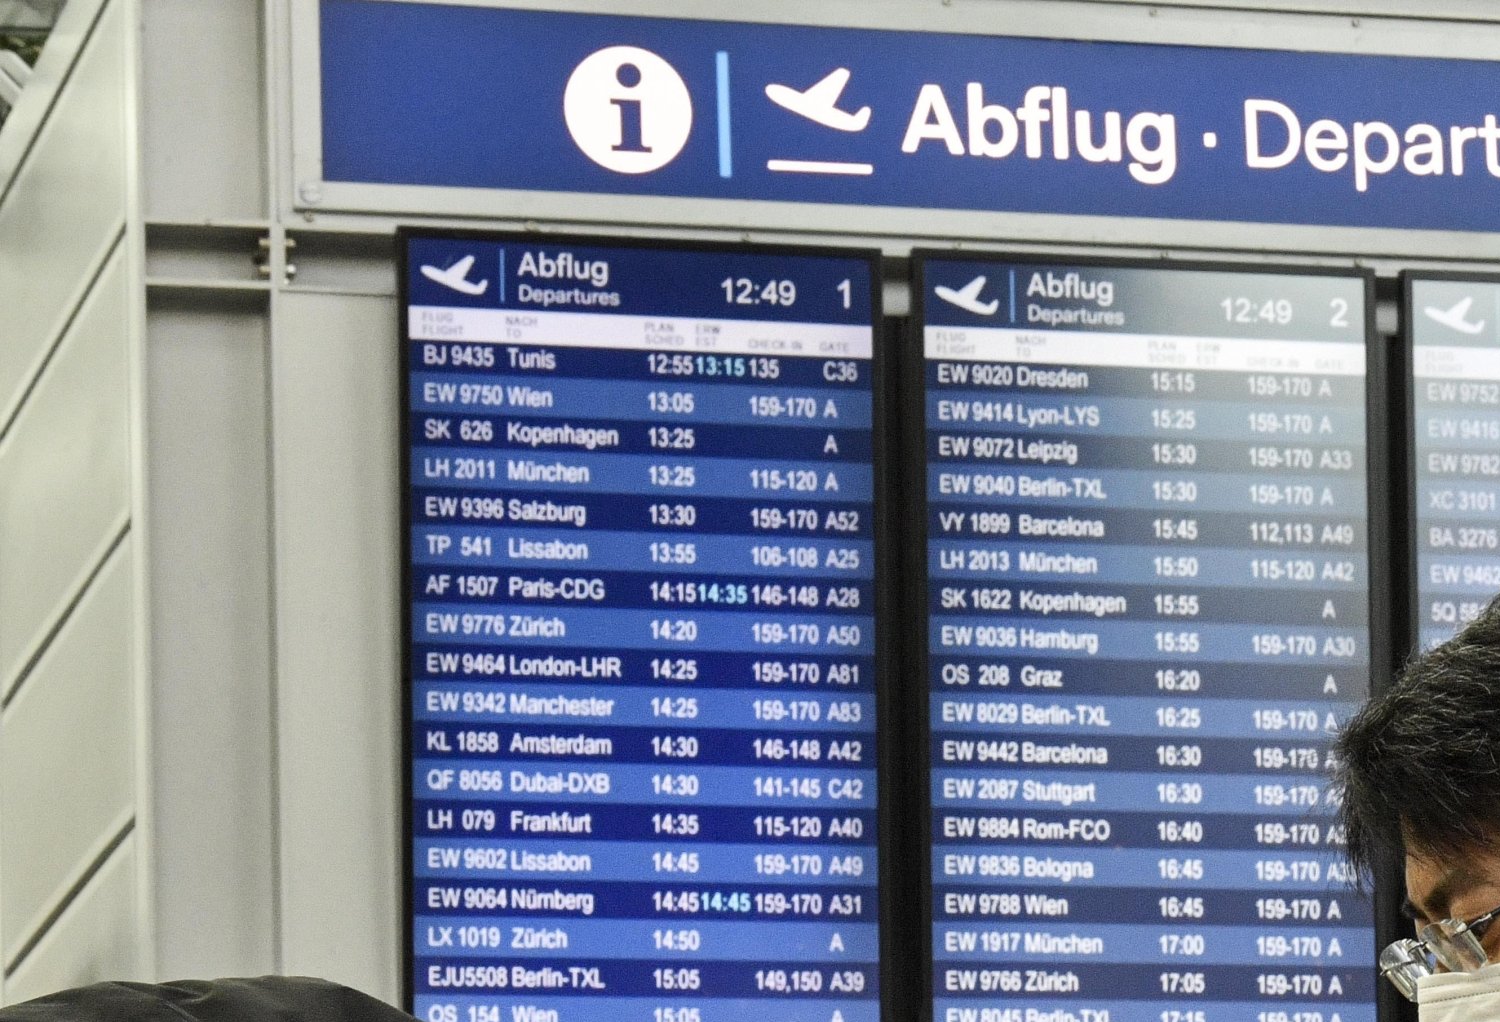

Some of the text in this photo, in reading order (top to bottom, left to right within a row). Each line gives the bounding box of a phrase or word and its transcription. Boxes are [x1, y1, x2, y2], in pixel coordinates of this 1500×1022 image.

[902, 83, 1177, 184] Abflug
[517, 252, 609, 287] Abflug
[519, 286, 620, 307] Departures
[720, 278, 851, 309] 12:49 1
[1028, 272, 1113, 306] Abflug
[1028, 305, 1125, 326] Departures
[1220, 297, 1348, 327] 12:49 2
[424, 346, 857, 381] BJ 9435 Tunis 12:55 13:15 135 C36
[938, 364, 1331, 396] EW 9020 Dresden 15:15 159-170 A
[1428, 383, 1458, 402] EW
[1461, 385, 1499, 402] 9752
[425, 420, 838, 453] SK 626 Kopenhagen 13:25 A
[425, 458, 838, 491] LH 2011 München 13:25 115-120 A
[1429, 455, 1459, 473] EW
[941, 513, 1353, 545] VY 1899 Barcelona 15:45 112,113 A49
[426, 576, 450, 595] AF
[457, 576, 497, 596] 1507
[509, 578, 604, 599] Paris-CDG
[650, 582, 696, 602] 14:15
[698, 583, 746, 603] 14:35
[751, 585, 817, 606] 146-148
[941, 589, 1335, 618] SK 1622 Kopenhagen 15:55 A
[427, 653, 858, 683] EW 9464 London-LHR 14:25 159-170 A81
[942, 665, 1337, 693] OS 208 Graz 16:20 A
[428, 810, 862, 839] LH 079 Frankfurt 14:35 115-120 A40
[429, 888, 861, 915] EW 9064 Nürnberg 14:45 14:45 159-170 A31
[946, 932, 1341, 956] EW 1917 München 17:00 159-170 A
[429, 966, 864, 993] EJU5508 Berlin-TXL 15:05 149,150 A39
